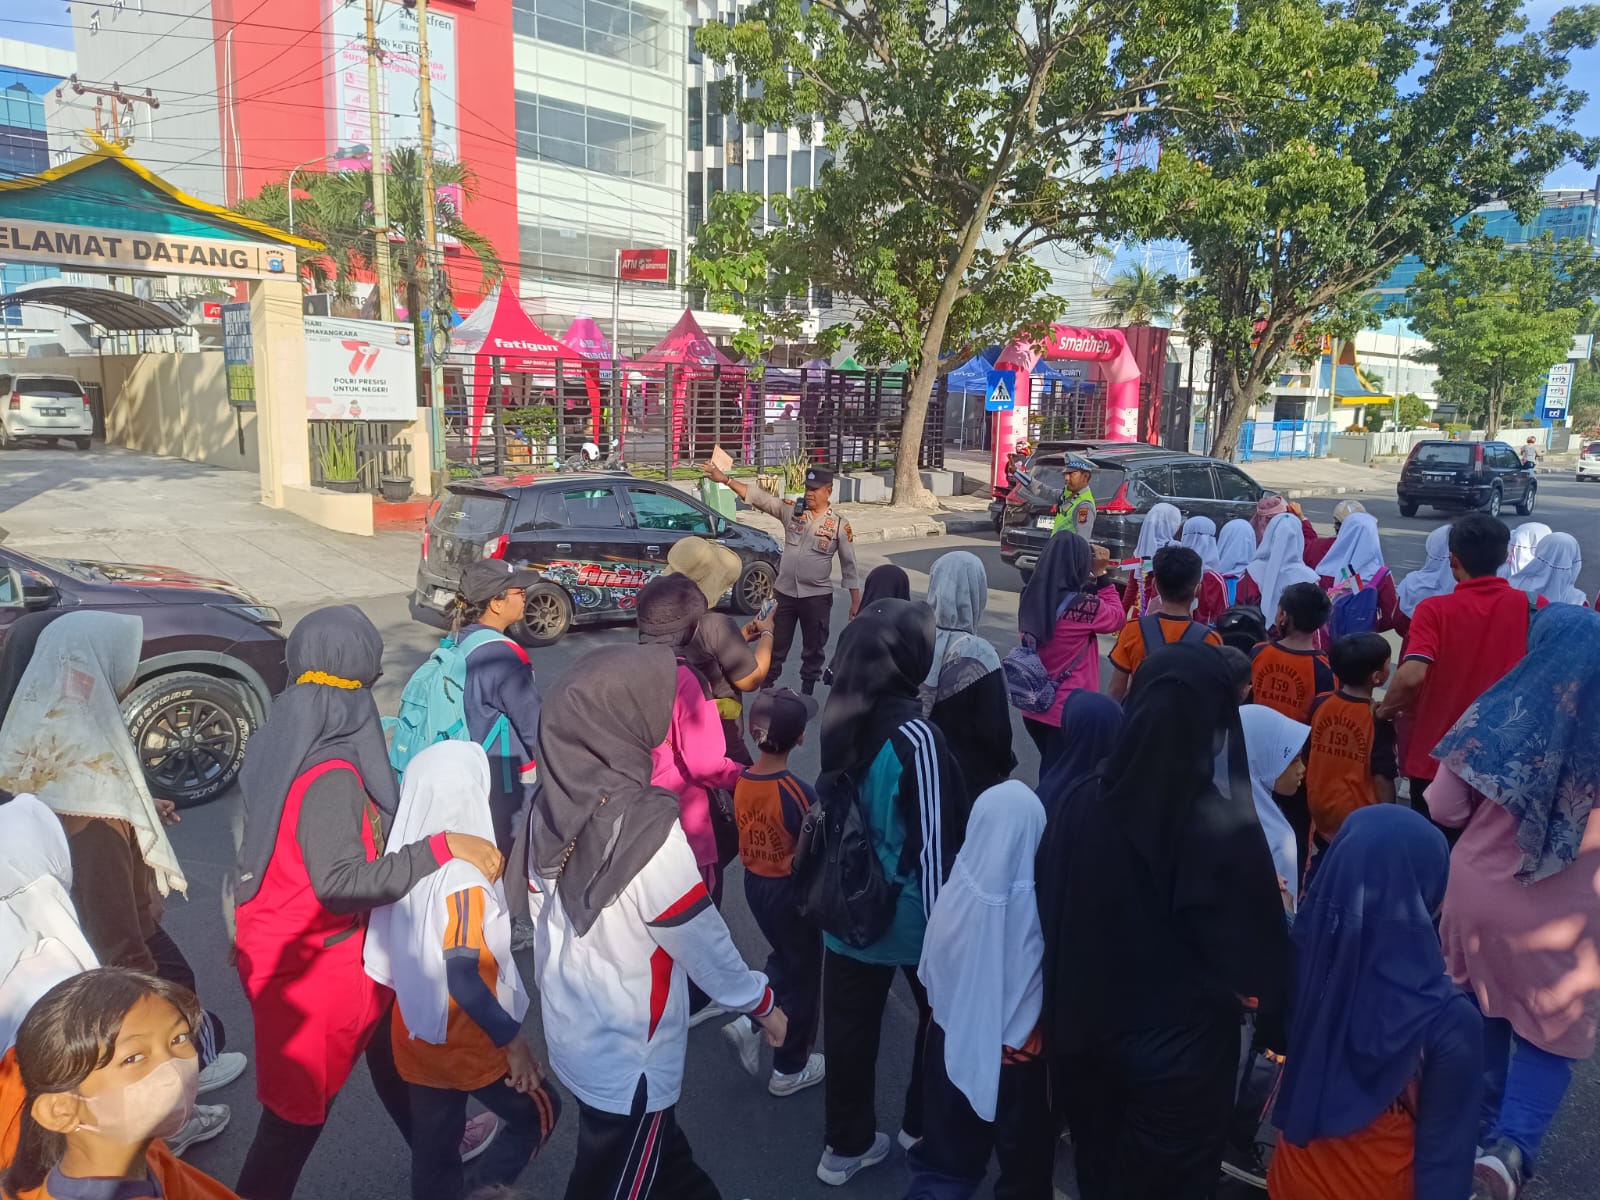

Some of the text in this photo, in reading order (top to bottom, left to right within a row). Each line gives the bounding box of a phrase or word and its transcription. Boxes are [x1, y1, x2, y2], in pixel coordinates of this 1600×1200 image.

[399, 10, 452, 30] smatfren
[132, 239, 248, 269] DATANG
[622, 259, 638, 270] ATM
[494, 338, 559, 352] fatigon
[333, 385, 360, 393] UNTUK
[334, 377, 387, 386] POLRI PRESISI
[1270, 677, 1289, 693] 159
[1329, 731, 1349, 747] 159
[748, 829, 766, 847] 159
[742, 846, 785, 863] KANBARU
